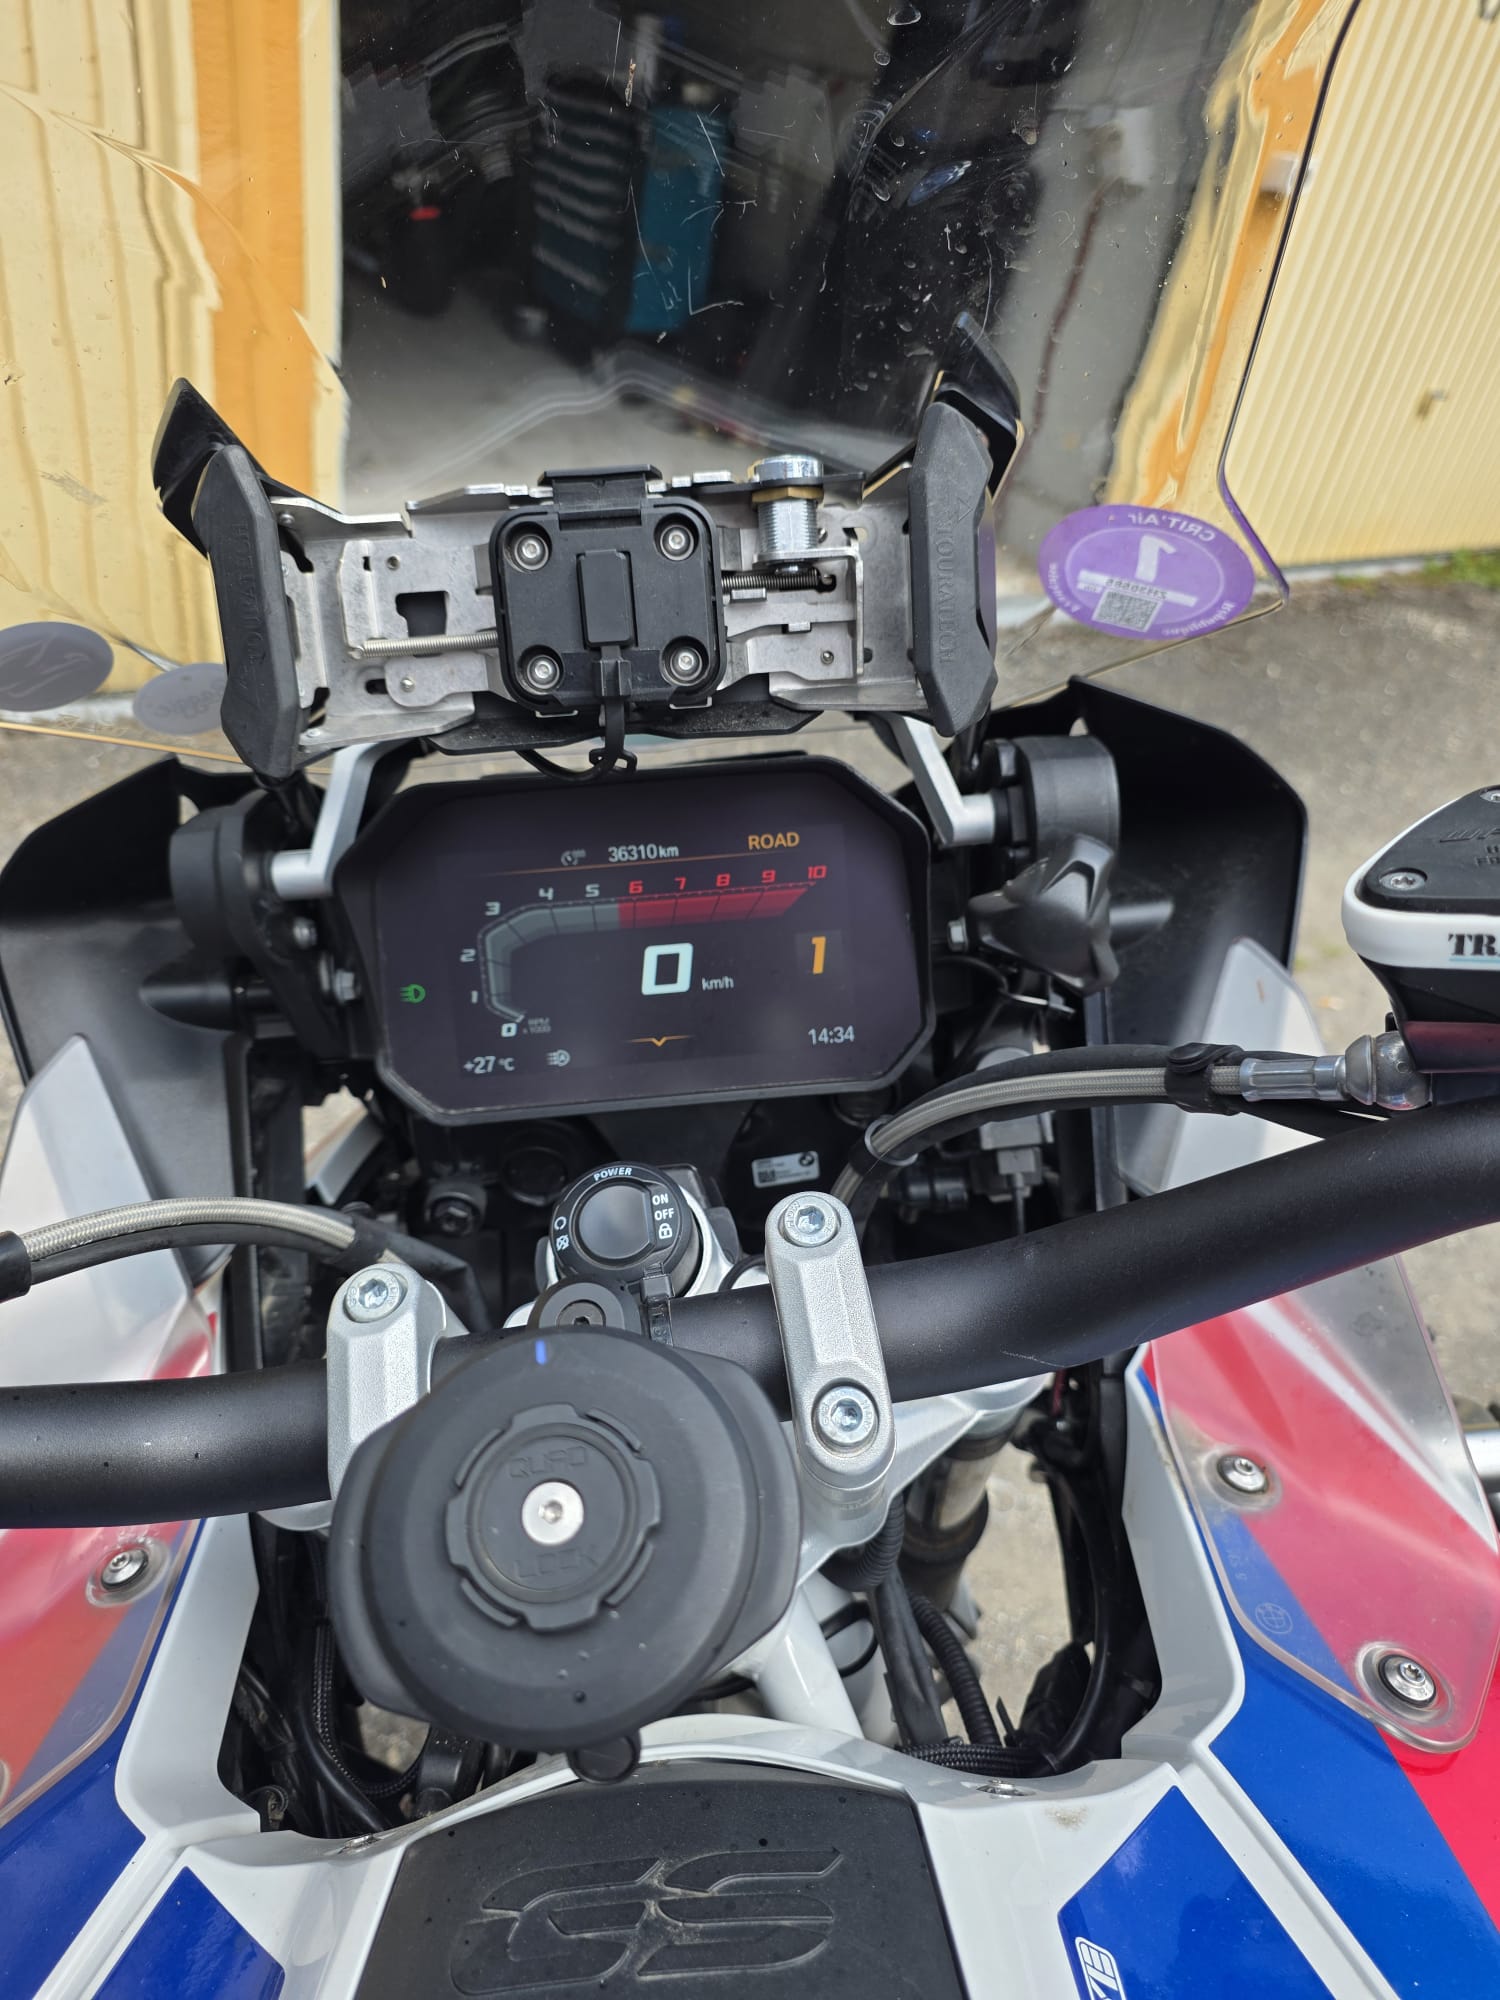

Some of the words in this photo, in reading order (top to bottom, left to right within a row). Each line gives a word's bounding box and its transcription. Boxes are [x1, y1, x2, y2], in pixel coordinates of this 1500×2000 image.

[748, 831, 800, 850] ROAD
[761, 869, 776, 884] 9
[807, 865, 827, 879] 10
[628, 880, 643, 894] 6
[674, 876, 686, 891] 7
[716, 873, 731, 887] 8
[538, 887, 555, 901] 4
[585, 883, 600, 898] 5
[485, 901, 501, 916] 3
[1447, 933, 1500, 957] TR
[460, 948, 476, 963] 2
[811, 936, 827, 974] 1
[641, 942, 694, 996] 0
[701, 976, 735, 991] km/h
[501, 1022, 518, 1038] 0
[808, 1025, 855, 1045] 14:34
[593, 1167, 633, 1182] POWER
[652, 1193, 669, 1206] ON
[654, 1207, 675, 1221] OFF
